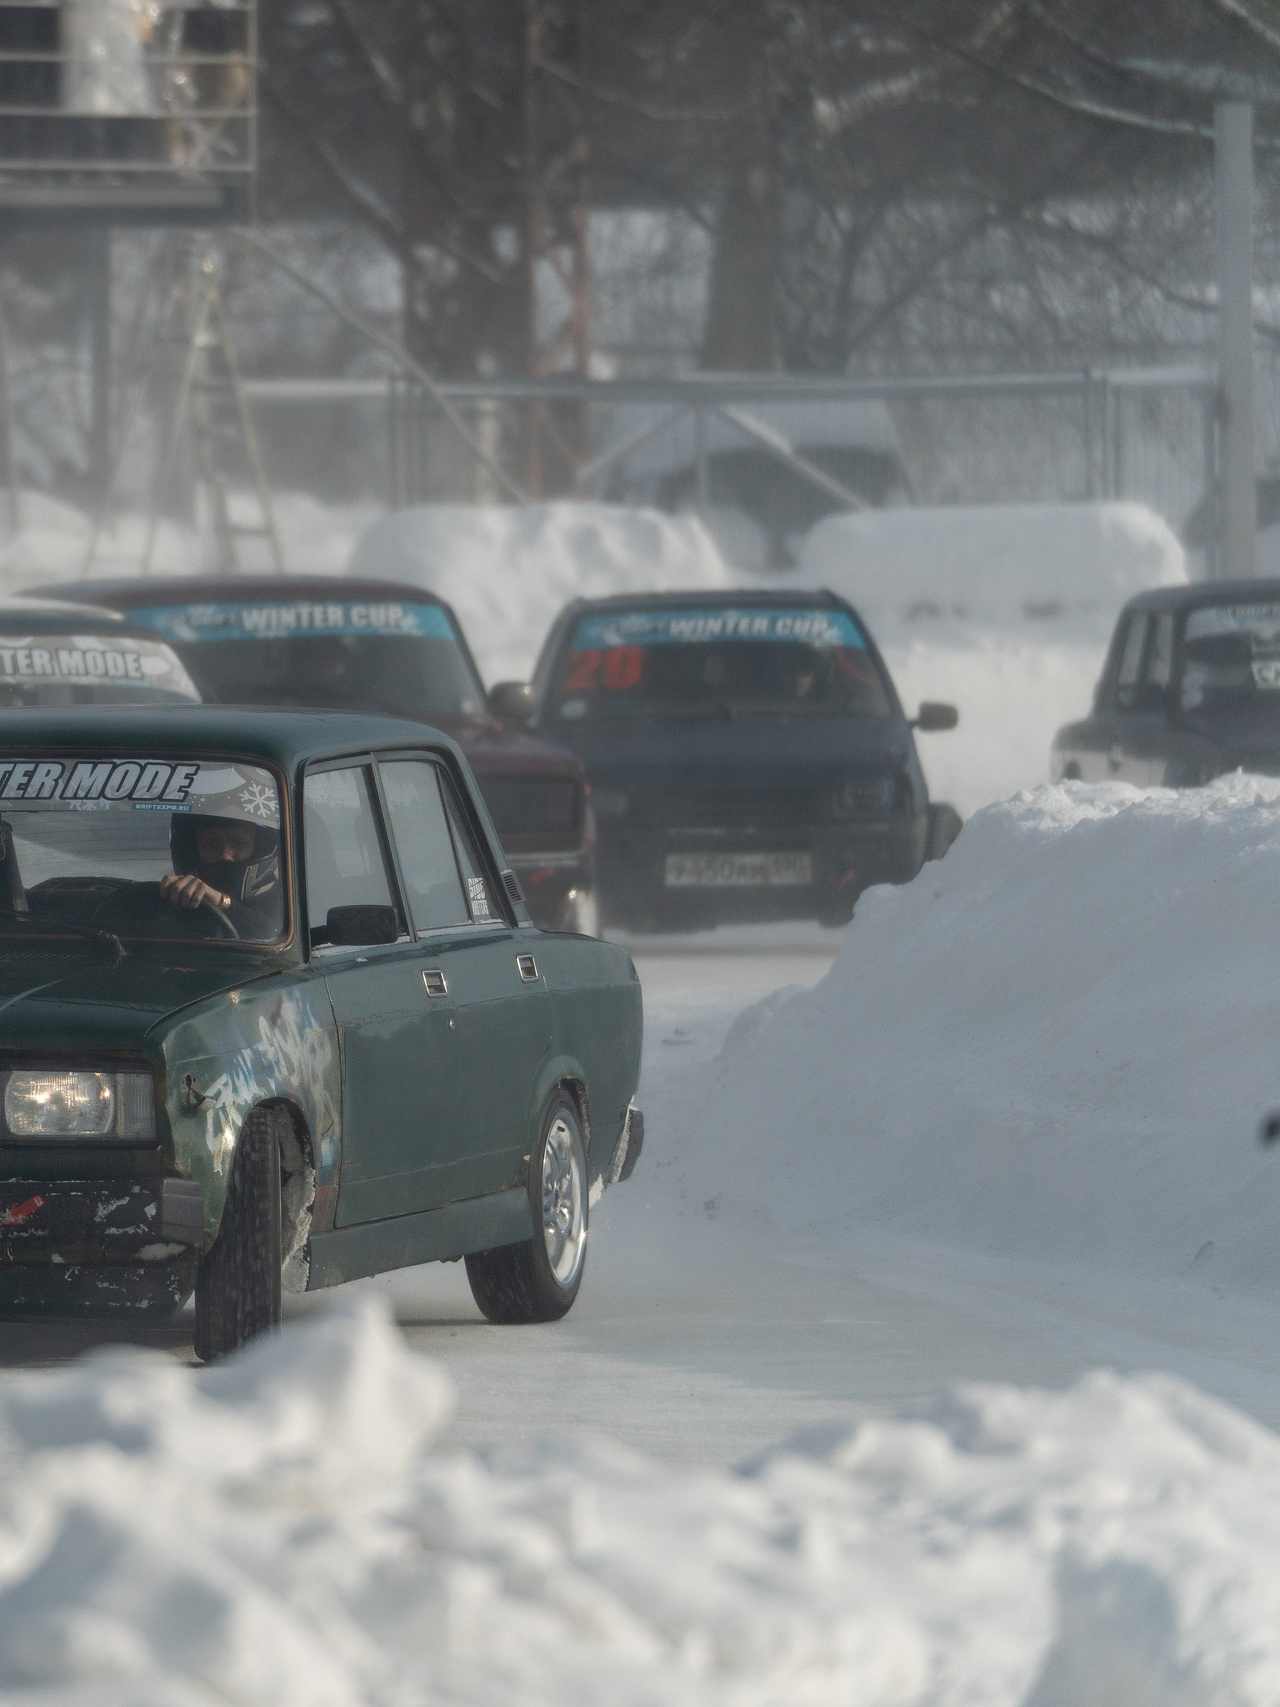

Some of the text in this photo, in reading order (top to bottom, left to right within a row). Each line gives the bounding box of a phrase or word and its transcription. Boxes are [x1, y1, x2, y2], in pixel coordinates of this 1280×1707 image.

[241, 604, 344, 631] WINTER
[350, 604, 404, 628] CUP
[669, 615, 769, 637] WINTER
[774, 614, 828, 636] CUP
[57, 650, 144, 679] MODE
[61, 761, 200, 802] MODE
[134, 802, 190, 812] DRIFTEXPO.RU
